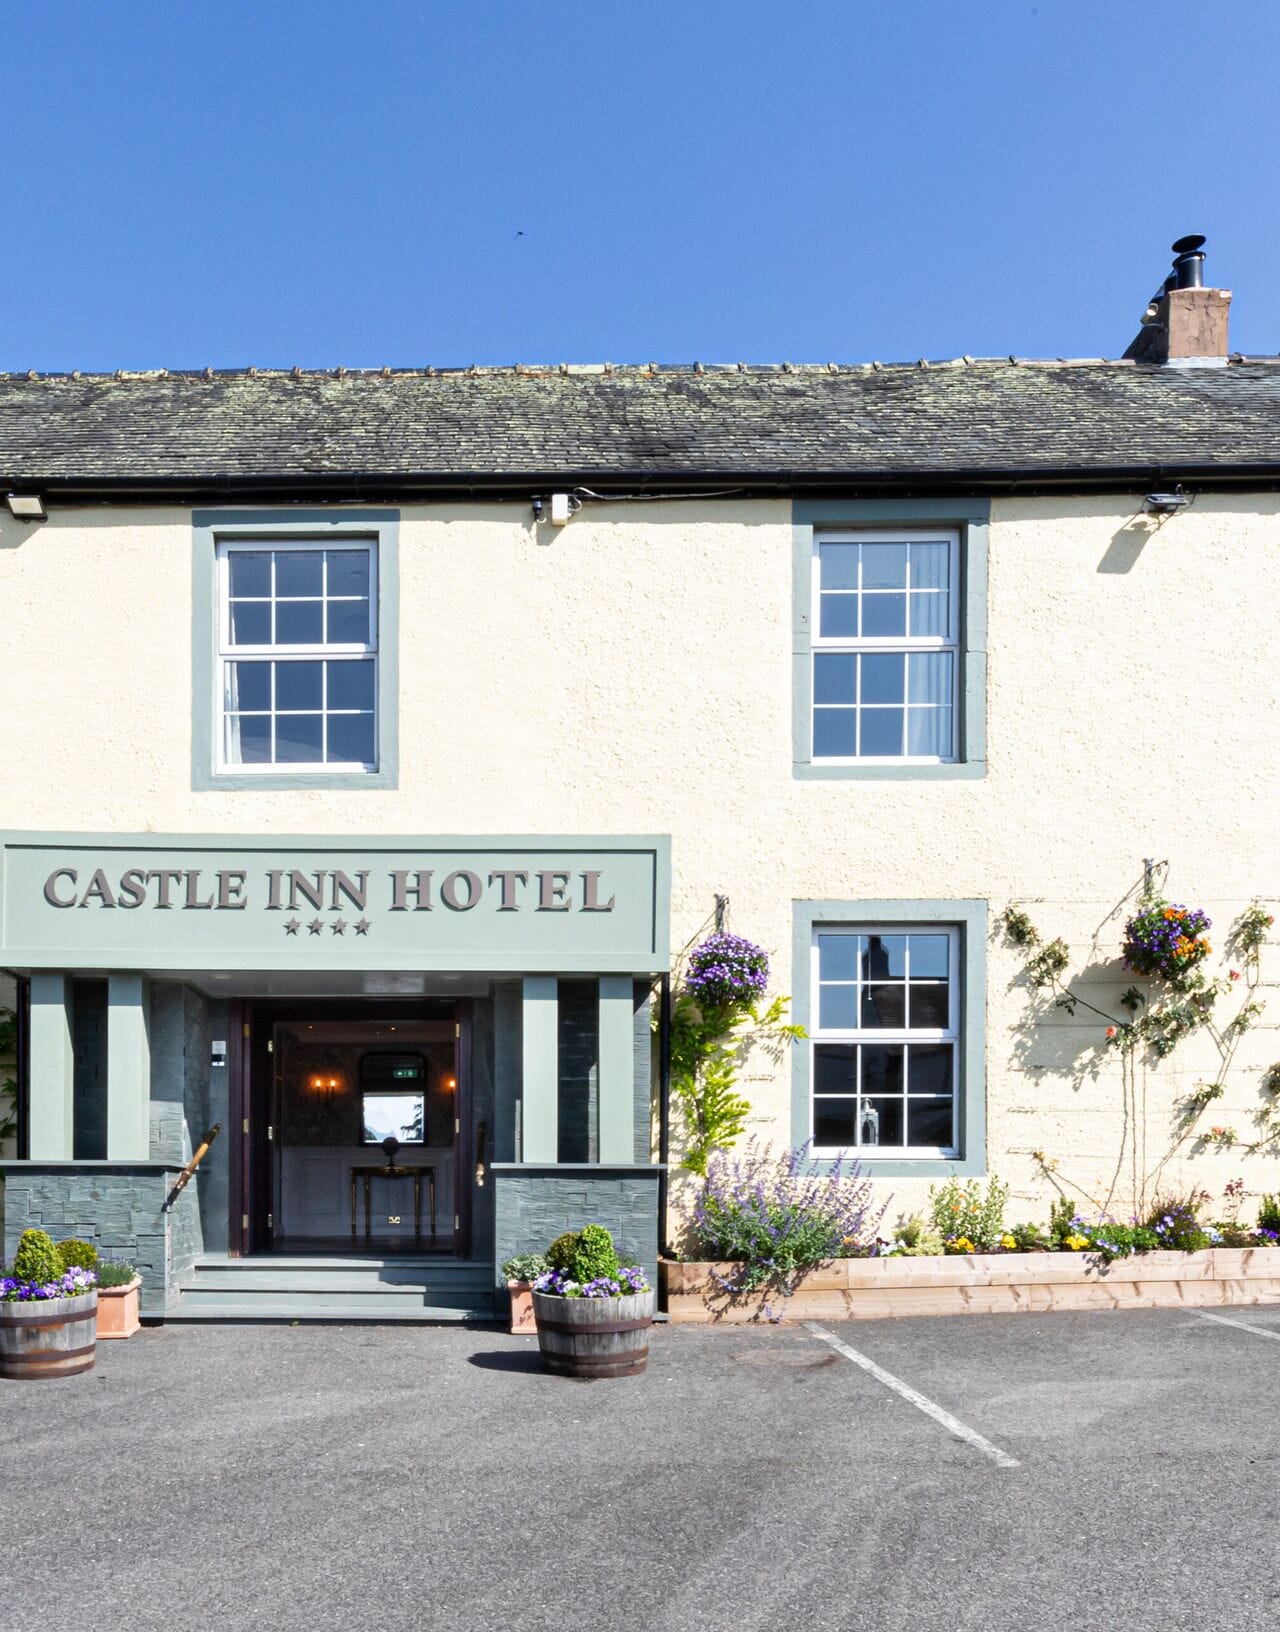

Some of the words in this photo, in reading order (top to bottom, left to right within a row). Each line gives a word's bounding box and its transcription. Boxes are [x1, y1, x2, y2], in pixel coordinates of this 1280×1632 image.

[44, 868, 247, 910] CASTLE
[264, 869, 370, 911] INN
[388, 869, 615, 912] HOTEL
